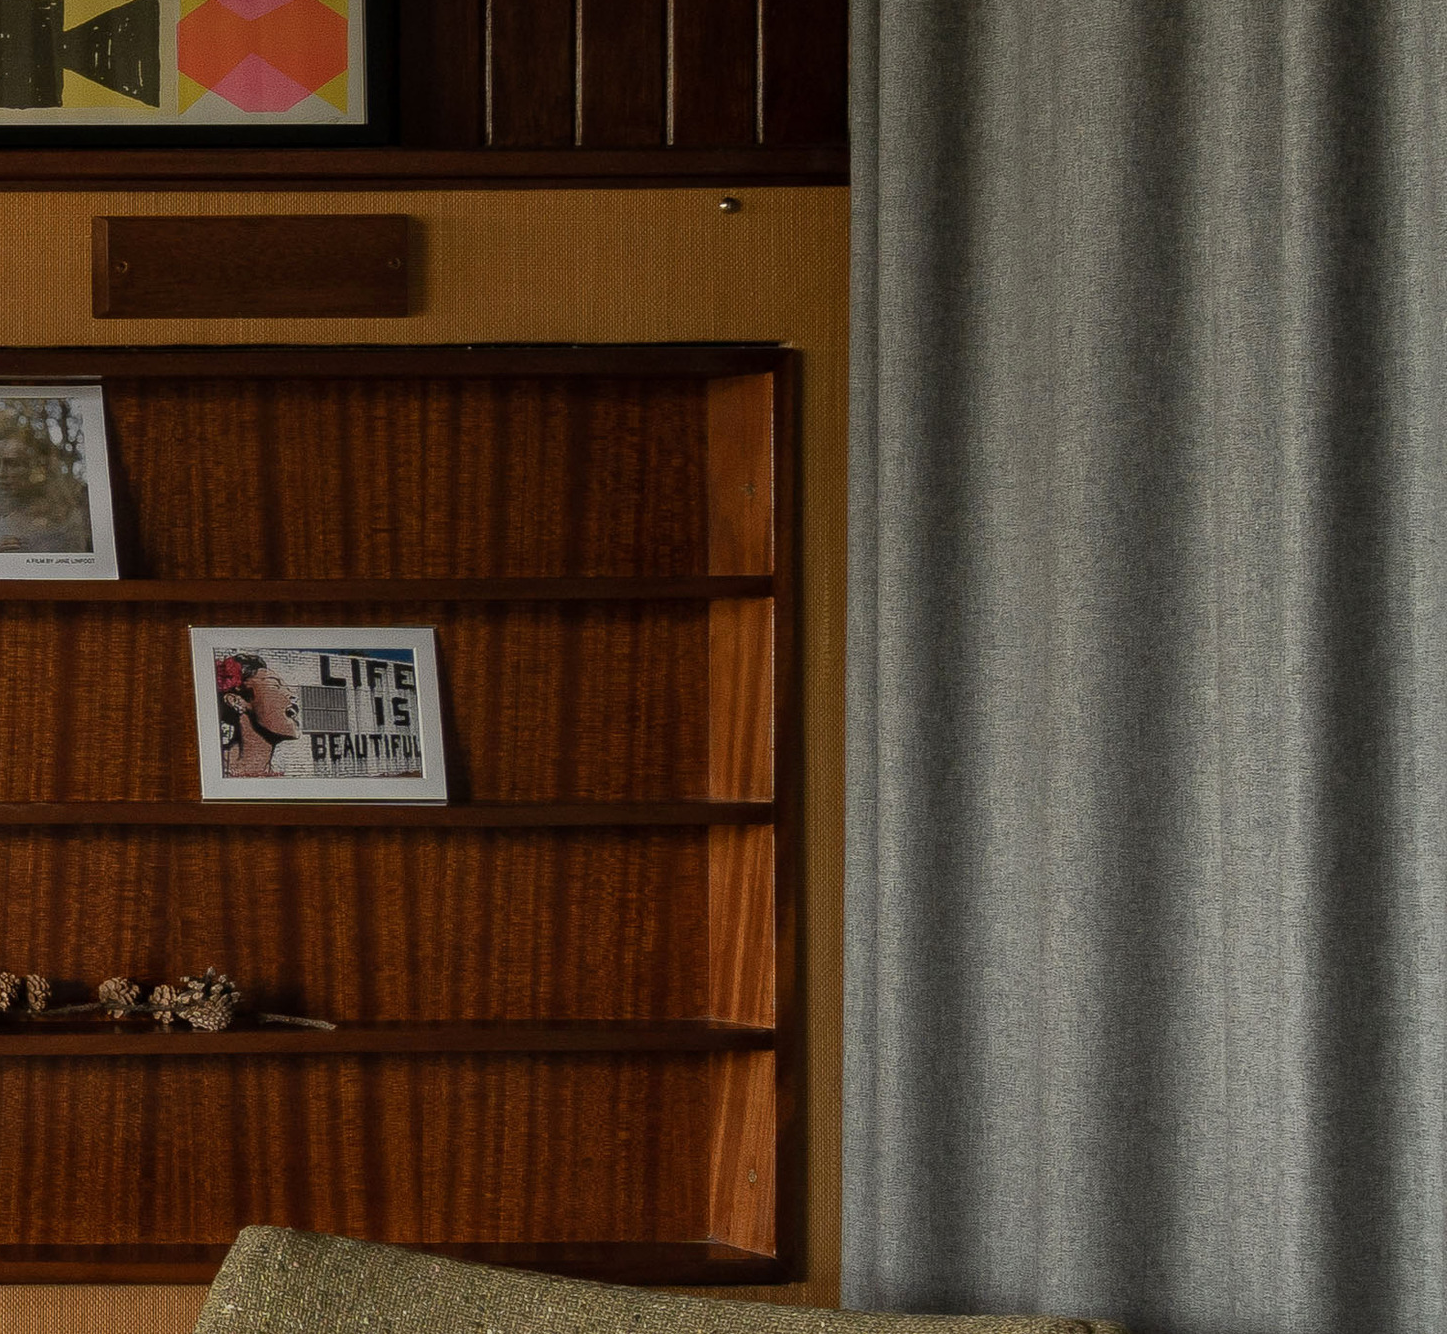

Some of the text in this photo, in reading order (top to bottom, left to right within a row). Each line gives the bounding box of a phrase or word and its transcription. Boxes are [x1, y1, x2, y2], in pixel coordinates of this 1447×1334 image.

[319, 655, 416, 689] LIFE
[374, 697, 410, 726] IS
[310, 732, 421, 762] BEAUTIFUL
